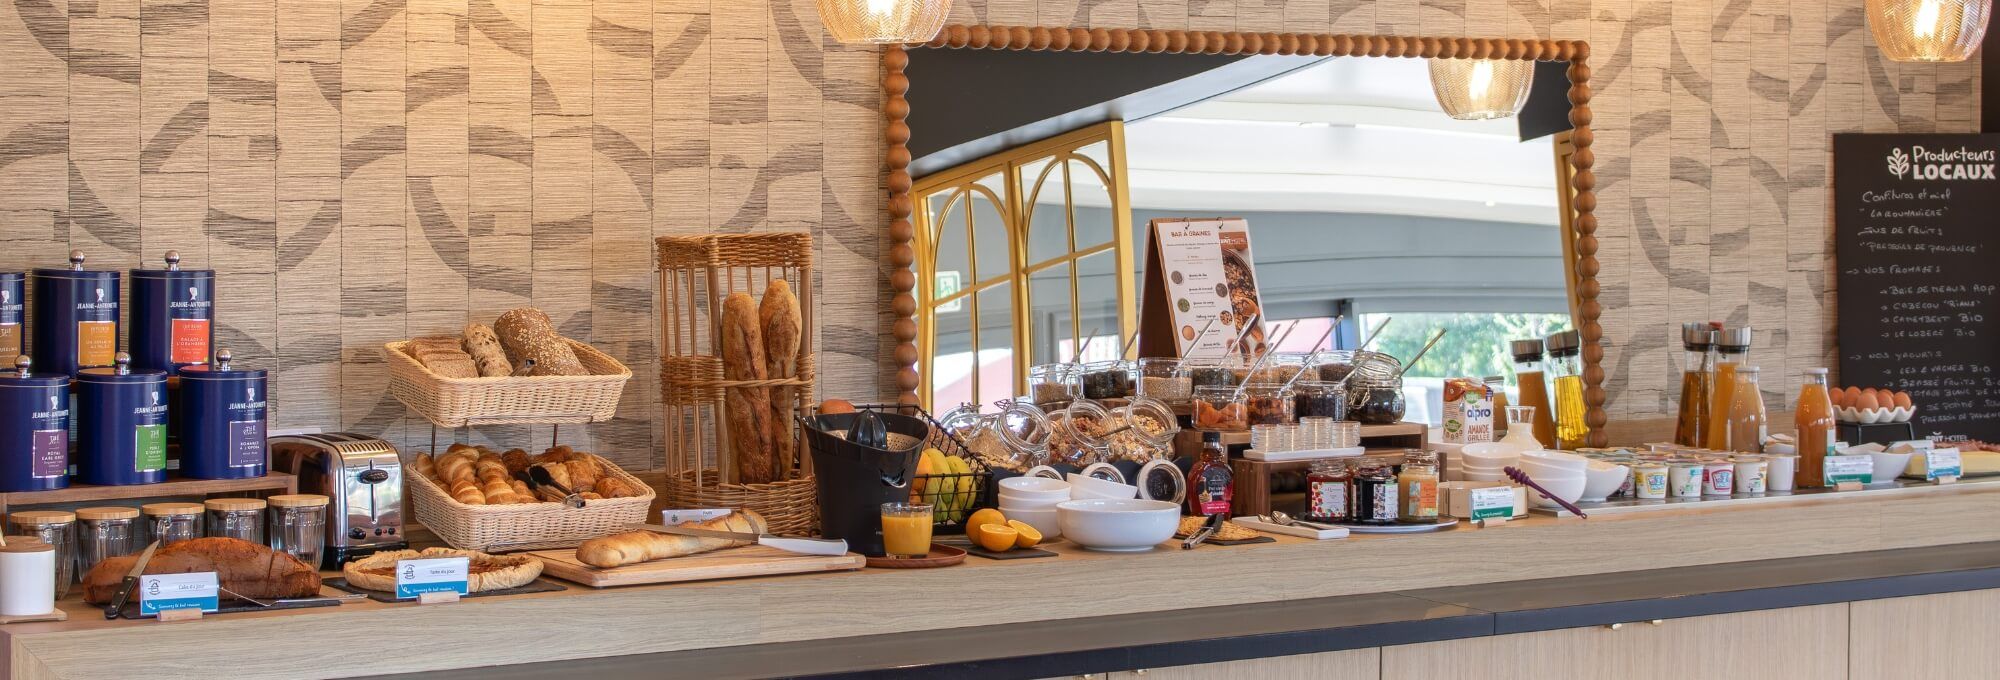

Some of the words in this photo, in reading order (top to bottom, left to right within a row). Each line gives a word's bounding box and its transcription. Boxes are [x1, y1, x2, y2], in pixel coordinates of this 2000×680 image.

[1913, 146, 1995, 162] Producteurs
[1913, 164, 1996, 180] LOCAUX
[1918, 188, 1927, 200] et
[1930, 187, 1951, 200] miel
[1891, 226, 1904, 235] DE
[1864, 266, 1885, 274] NOS
[1889, 264, 1941, 275] FROMAGES
[1916, 286, 1929, 294] DE
[1972, 283, 1996, 296] AOP
[1467, 405, 1491, 421] alpro
[1468, 424, 1490, 434] AMANDE
